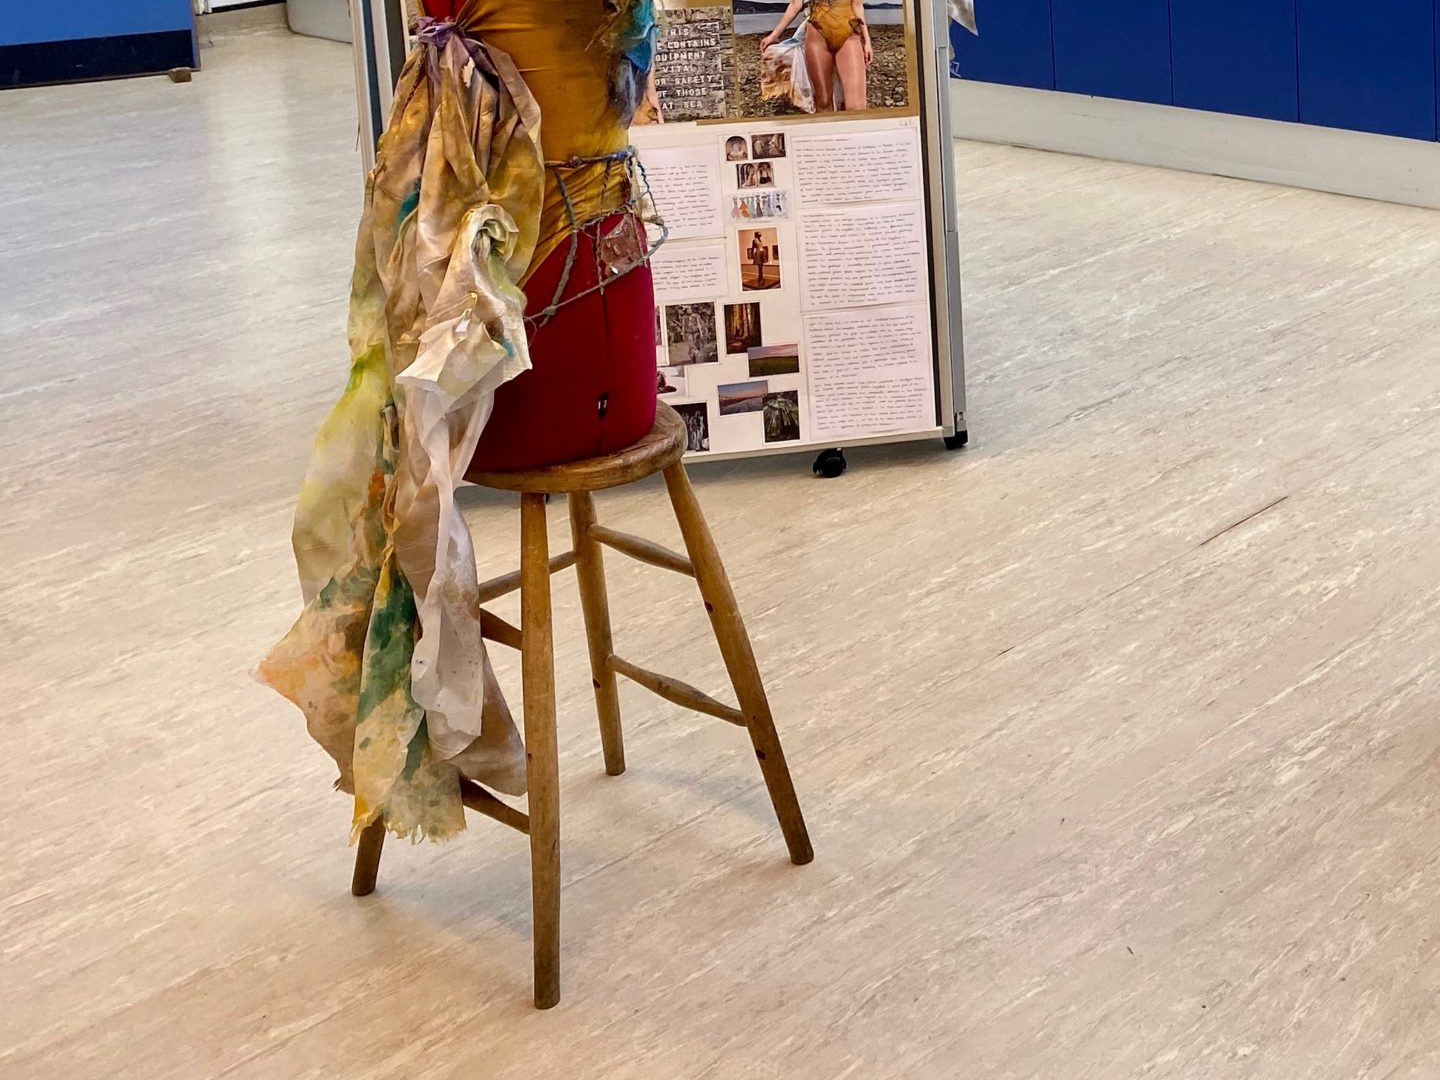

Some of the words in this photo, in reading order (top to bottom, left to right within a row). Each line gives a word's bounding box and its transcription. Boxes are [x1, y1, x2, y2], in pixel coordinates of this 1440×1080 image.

[667, 38, 717, 50] CONTAINS
[655, 50, 707, 63] QUIPMENT
[674, 74, 714, 86] SAFETY
[676, 87, 708, 98] THOSE
